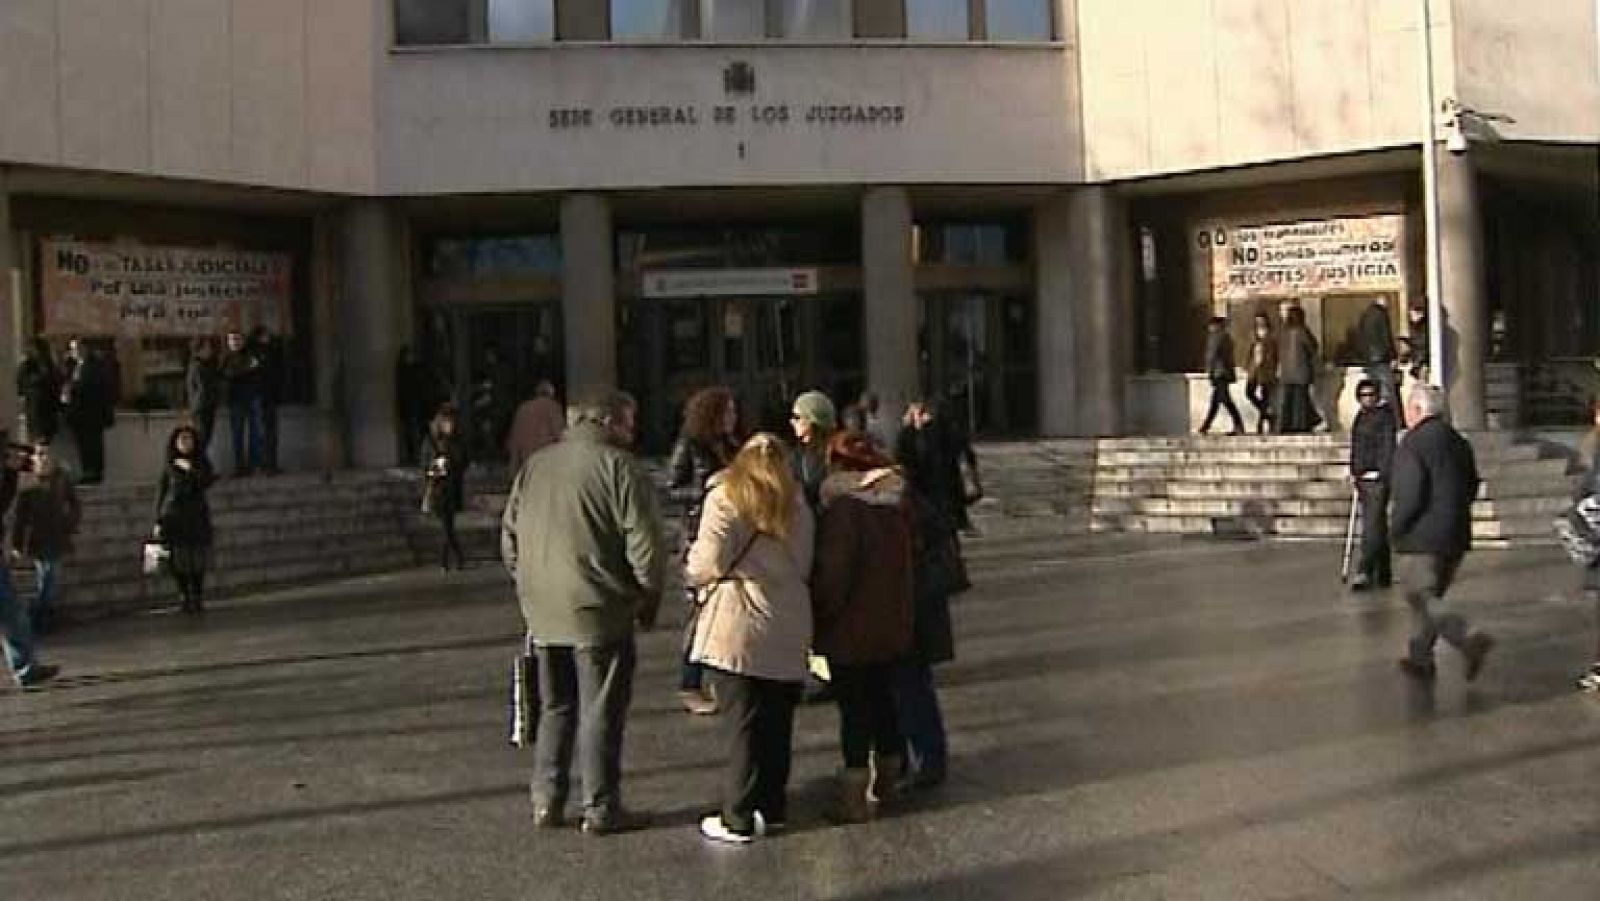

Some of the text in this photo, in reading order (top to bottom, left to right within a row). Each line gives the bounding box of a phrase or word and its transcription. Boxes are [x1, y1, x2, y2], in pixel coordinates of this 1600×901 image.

[549, 104, 905, 128] SEDE GENERAL DE LOS JUZGADOS
[56, 249, 90, 275] NO
[1231, 247, 1258, 266] NO
[1318, 264, 1397, 282] JUSTICIA
